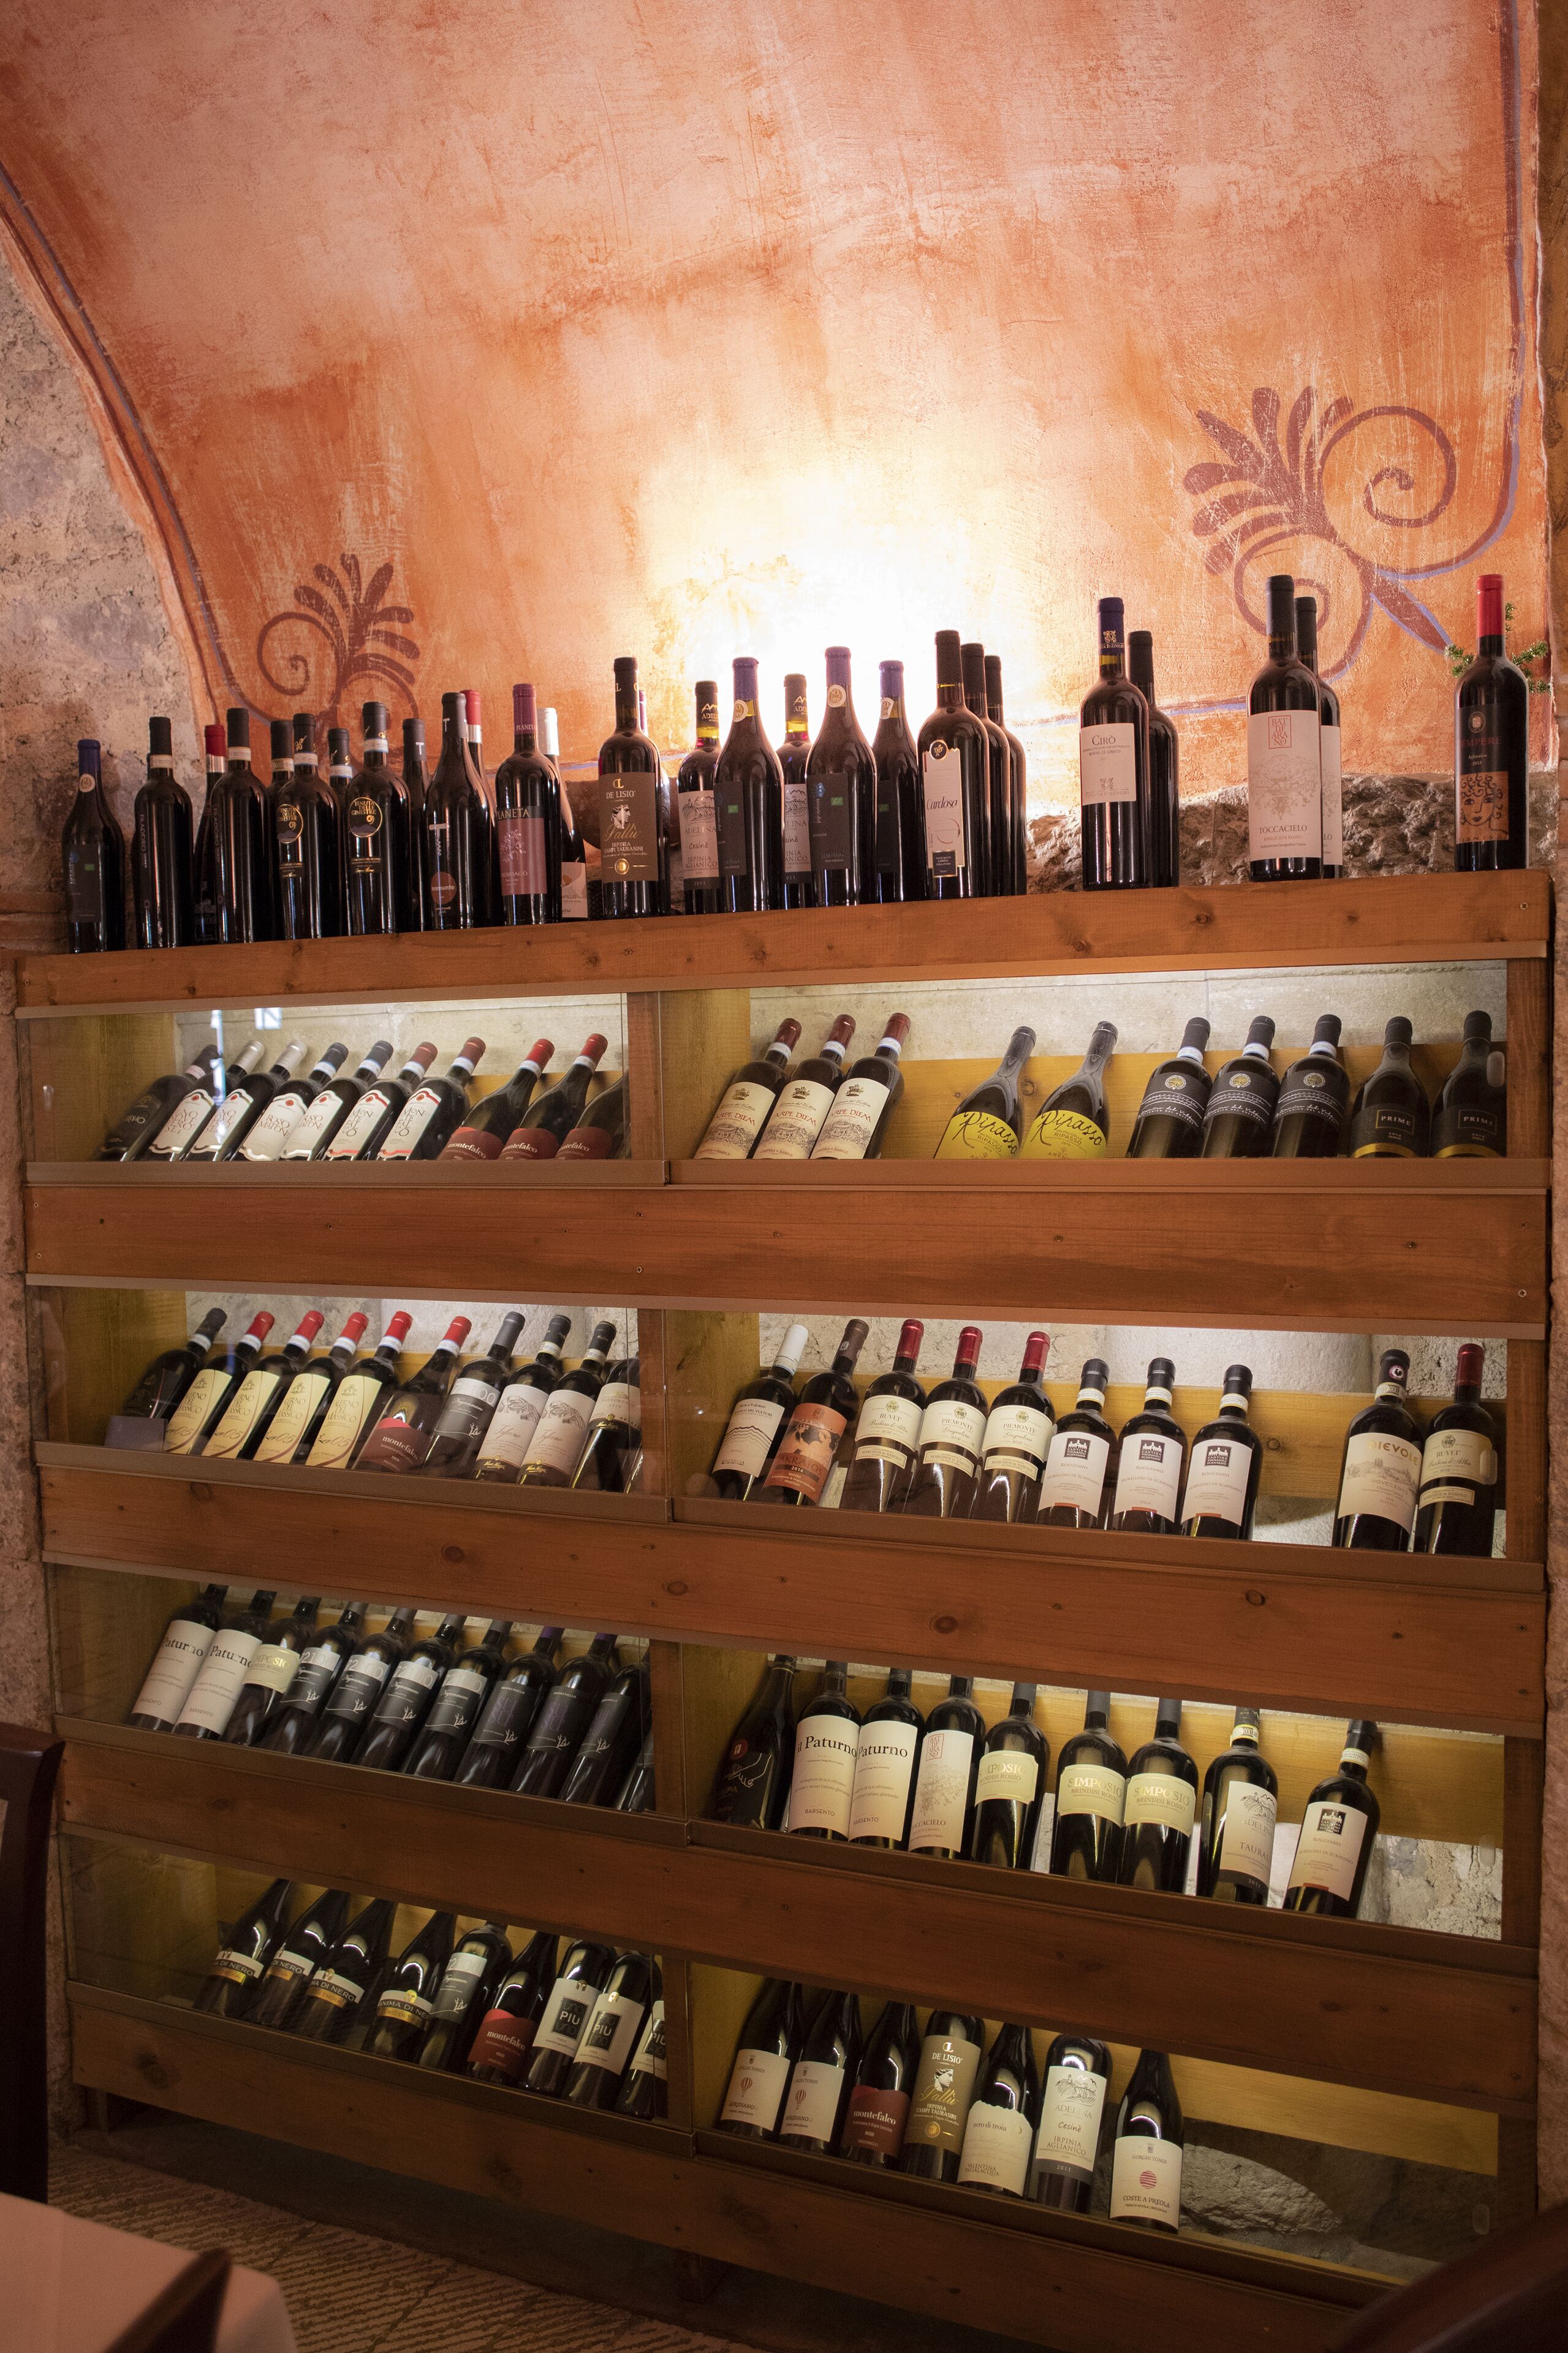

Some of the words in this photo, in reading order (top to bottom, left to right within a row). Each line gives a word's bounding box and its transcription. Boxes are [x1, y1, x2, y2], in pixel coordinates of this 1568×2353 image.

[926, 797, 958, 810] Cardosa
[1259, 825, 1307, 834] TOCCACIELO
[734, 1112, 756, 1126] DIEM
[797, 1112, 817, 1126] DIEM
[850, 1109, 871, 1122] DIEM
[1381, 1116, 1411, 1126] PRIME
[1463, 1116, 1493, 1126] PRIME
[952, 1112, 1017, 1154] Ripasso
[1031, 1110, 1102, 1145] Ripasso
[977, 1135, 1002, 1153] RIPASSO
[1054, 1132, 1082, 1145] RIPASSO
[447, 1142, 486, 1159] montefalco
[941, 1418, 974, 1431] PIEMONTE
[1004, 1423, 1036, 1434] PIEMONTE
[382, 1436, 418, 1460] montefalco
[1368, 1442, 1418, 1466] DIEVOLE
[1077, 1474, 1100, 1486] SCANSANO
[1153, 1477, 1175, 1490] SCANSANO
[1219, 1482, 1242, 1493] SCANSANO
[797, 1742, 802, 1753] il
[805, 1736, 857, 1757] Paturno
[1067, 1777, 1122, 1798] SIMPOSIO
[1101, 1792, 1118, 1802] ROSSO
[1134, 1786, 1190, 1806] SIMPOSIO
[1166, 1800, 1185, 1811] ROSSO
[1312, 1838, 1341, 1846] ROGGIANO
[1330, 1852, 1354, 1864] SCANSANO
[229, 1963, 254, 1976] NERO
[281, 1960, 302, 1974] NERO
[333, 1985, 355, 2001] NERO
[559, 2012, 580, 2025] PIU
[594, 2023, 612, 2036] PIU
[487, 2030, 526, 2050] montefalco
[942, 2054, 961, 2064] LISIO
[729, 2101, 754, 2110] MERIDIANO
[1055, 2105, 1092, 2119] ADELINA
[854, 2111, 896, 2124] montefalco
[931, 2109, 956, 2120] TAURASINI
[1058, 2121, 1081, 2132] Cesinè
[1054, 2136, 1081, 2147] IRPINIA
[1047, 2142, 1086, 2156] AGLIANICO
[964, 2167, 999, 2177] PASSALACQUA
[1148, 2197, 1170, 2208] PREOLA
